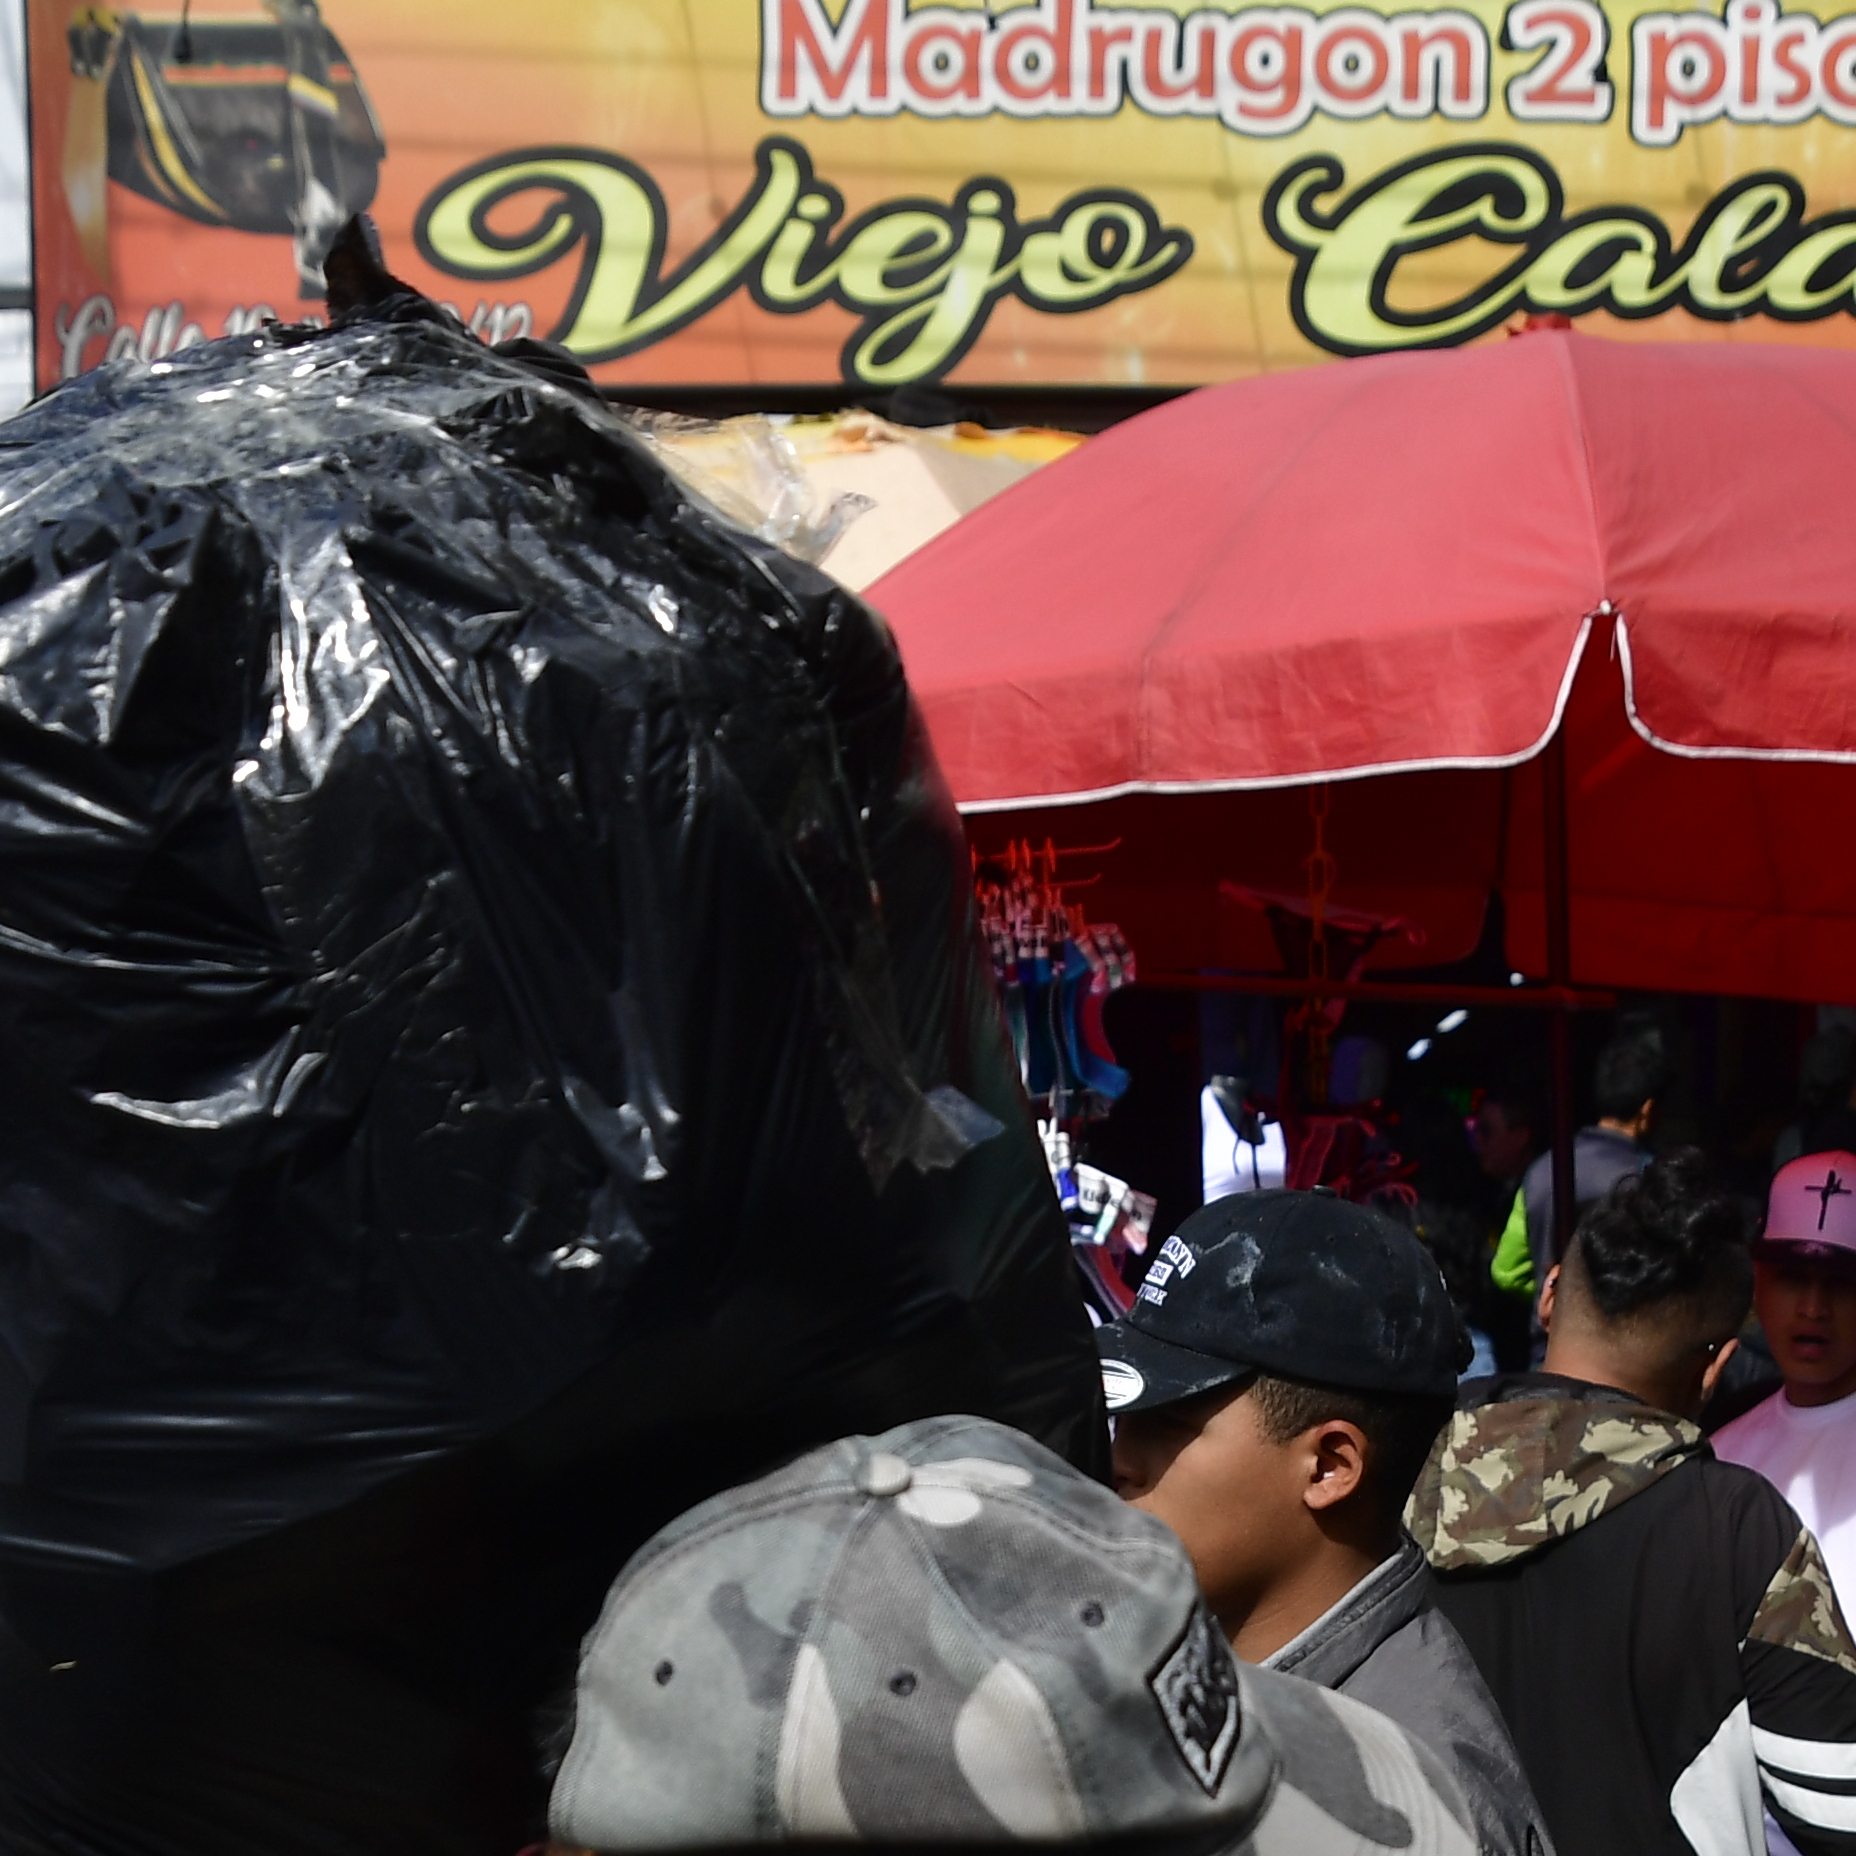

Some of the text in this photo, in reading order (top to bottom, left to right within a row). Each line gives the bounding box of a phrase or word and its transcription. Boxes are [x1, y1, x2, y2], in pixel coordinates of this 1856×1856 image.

[770, 0, 1482, 124] Madrugon
[1516, 4, 1604, 112] 2
[418, 138, 1190, 386] Viejo
